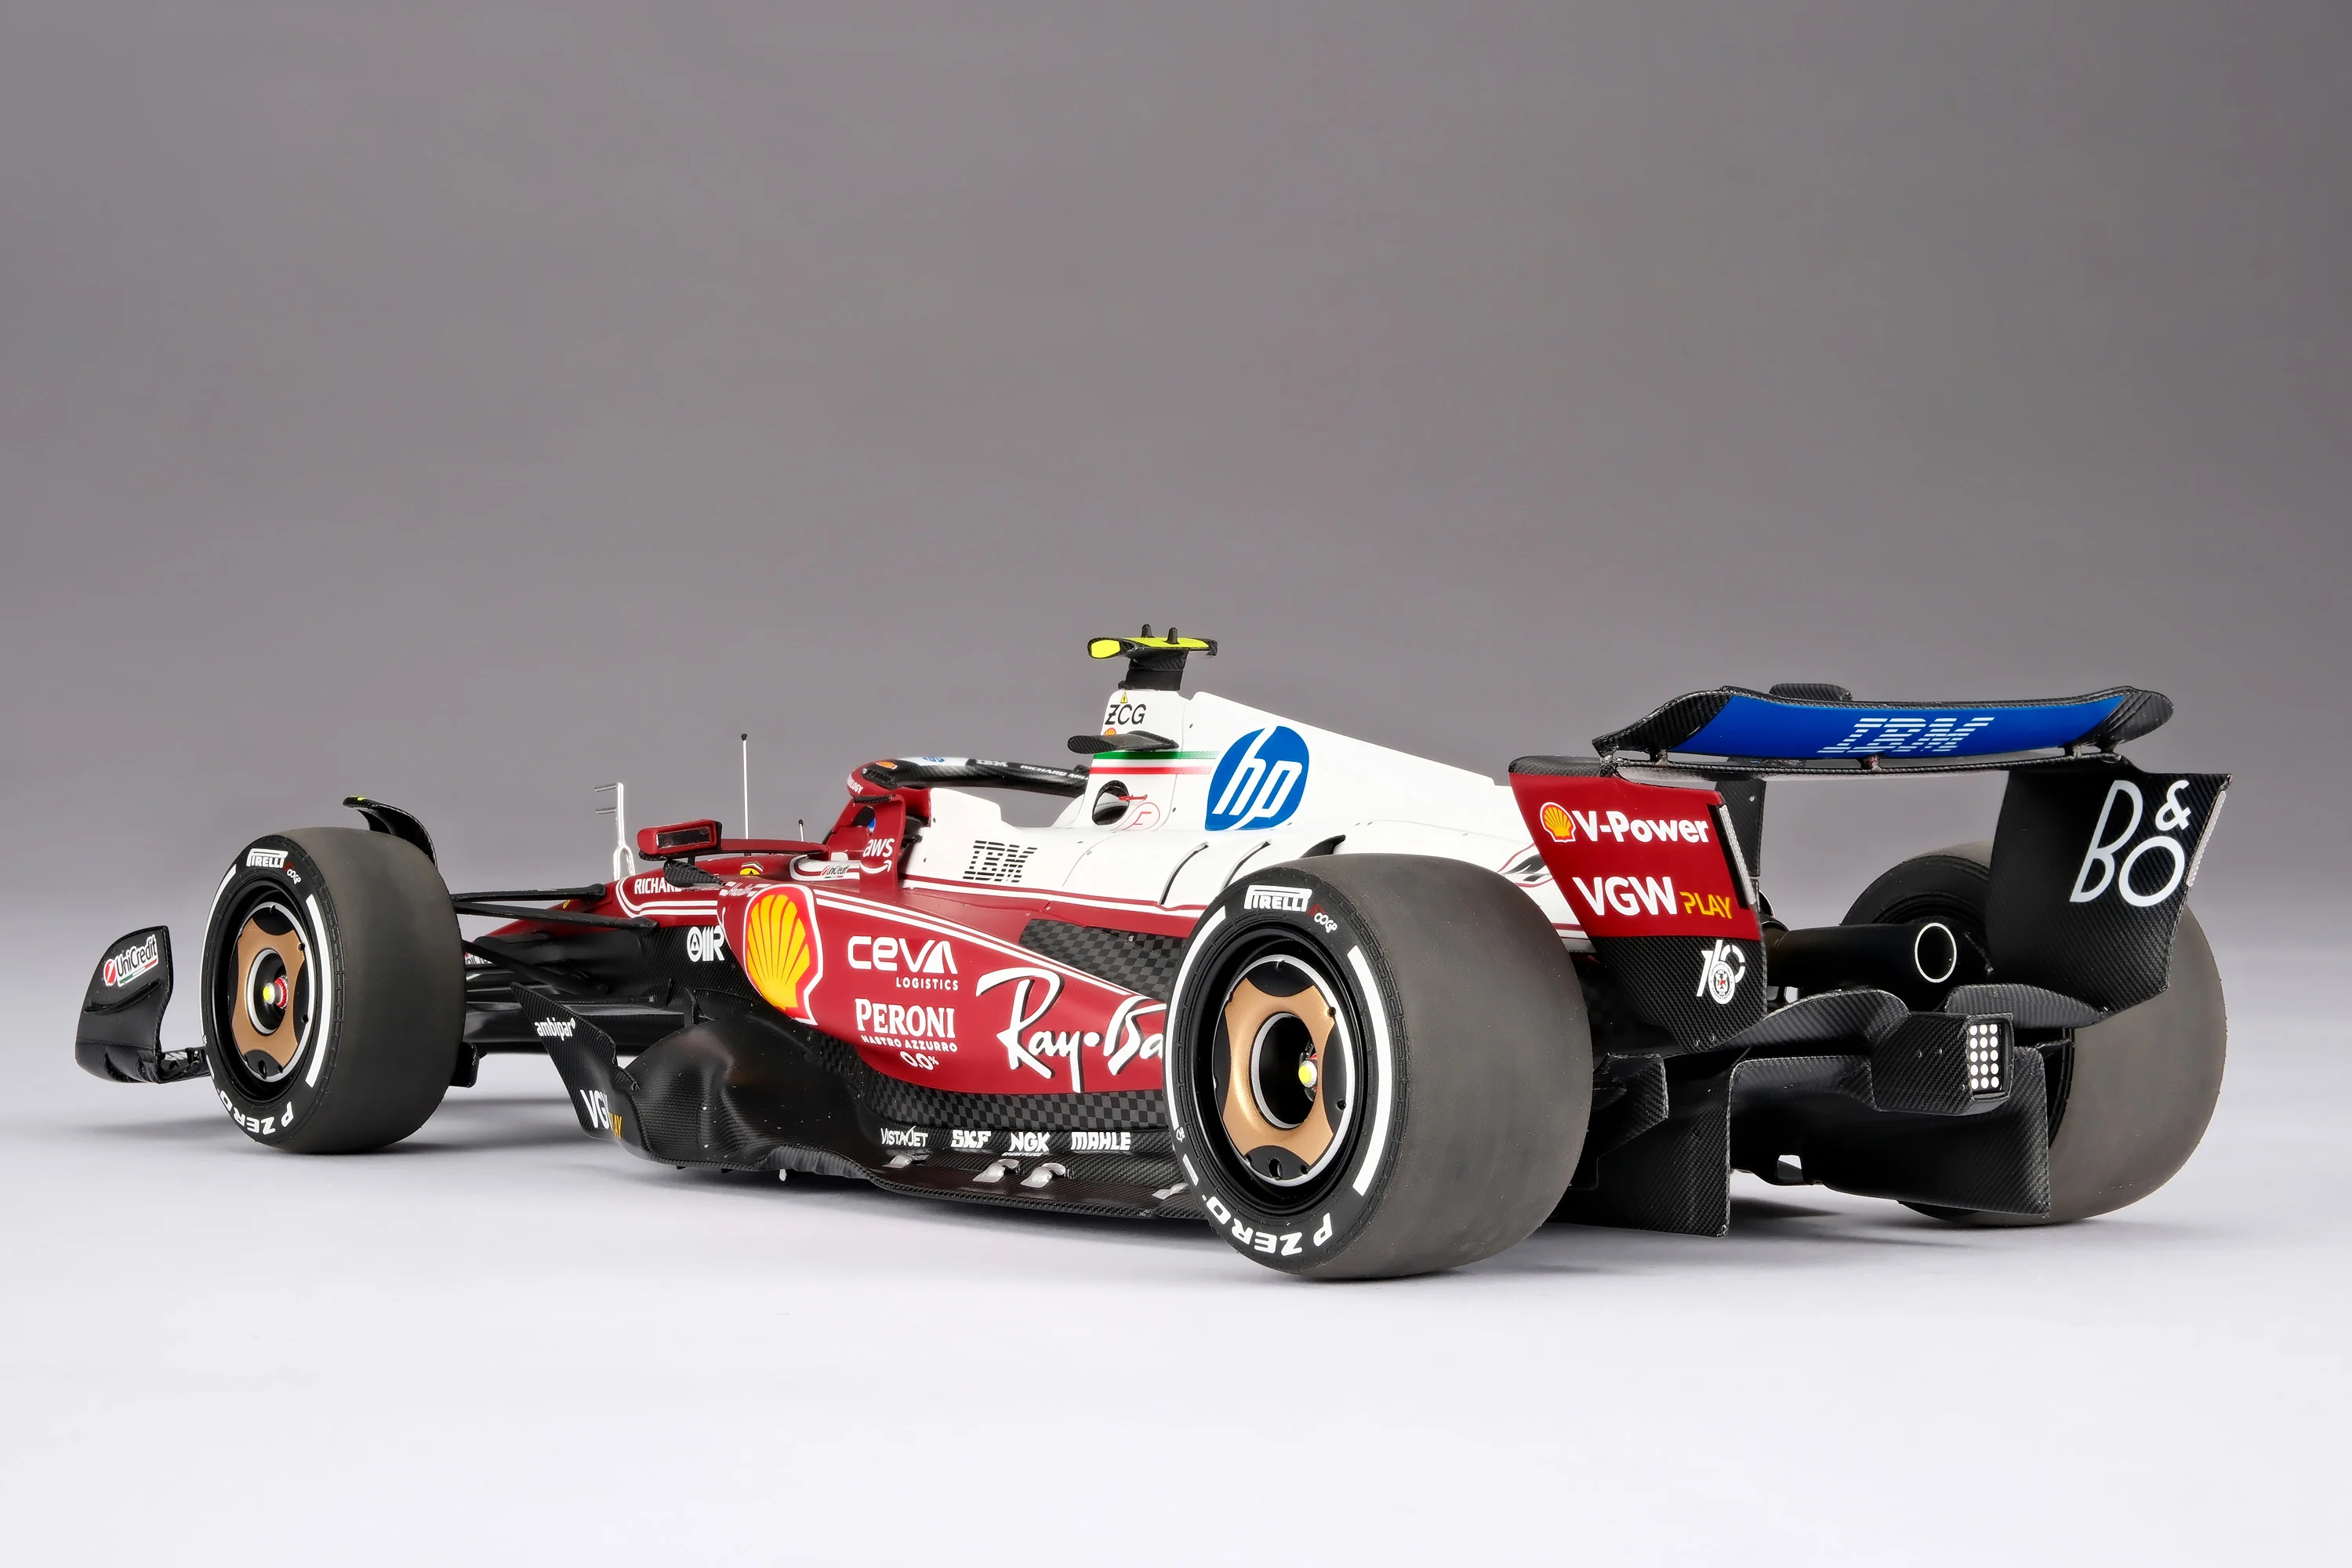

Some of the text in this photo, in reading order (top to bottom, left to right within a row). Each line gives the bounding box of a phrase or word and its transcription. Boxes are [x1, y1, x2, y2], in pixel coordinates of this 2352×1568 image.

[1105, 703, 1147, 725] ZCG
[1817, 717, 1994, 753] IBM
[1020, 764, 1067, 776] RICHARD
[1210, 726, 1305, 830] hp
[1571, 810, 1709, 843] V-Power
[246, 848, 289, 869] PIRELLI
[862, 838, 895, 858] aws
[962, 840, 1039, 883] IBM
[634, 877, 683, 895] RICHA
[1243, 884, 1313, 913] PIRELLI
[1572, 876, 1733, 920] VGW PLAY
[115, 935, 158, 978] UniCredit
[895, 976, 959, 991] LOGISTICS
[855, 997, 956, 1038] PERONI
[861, 1034, 958, 1052] NASTRO AZZURRO
[220, 1090, 294, 1135] P ZERO
[951, 1130, 991, 1149] SKF
[1007, 1131, 1050, 1152] NGK
[1070, 1131, 1131, 1151] MAHLE
[1206, 1196, 1333, 1256] P ZERO
